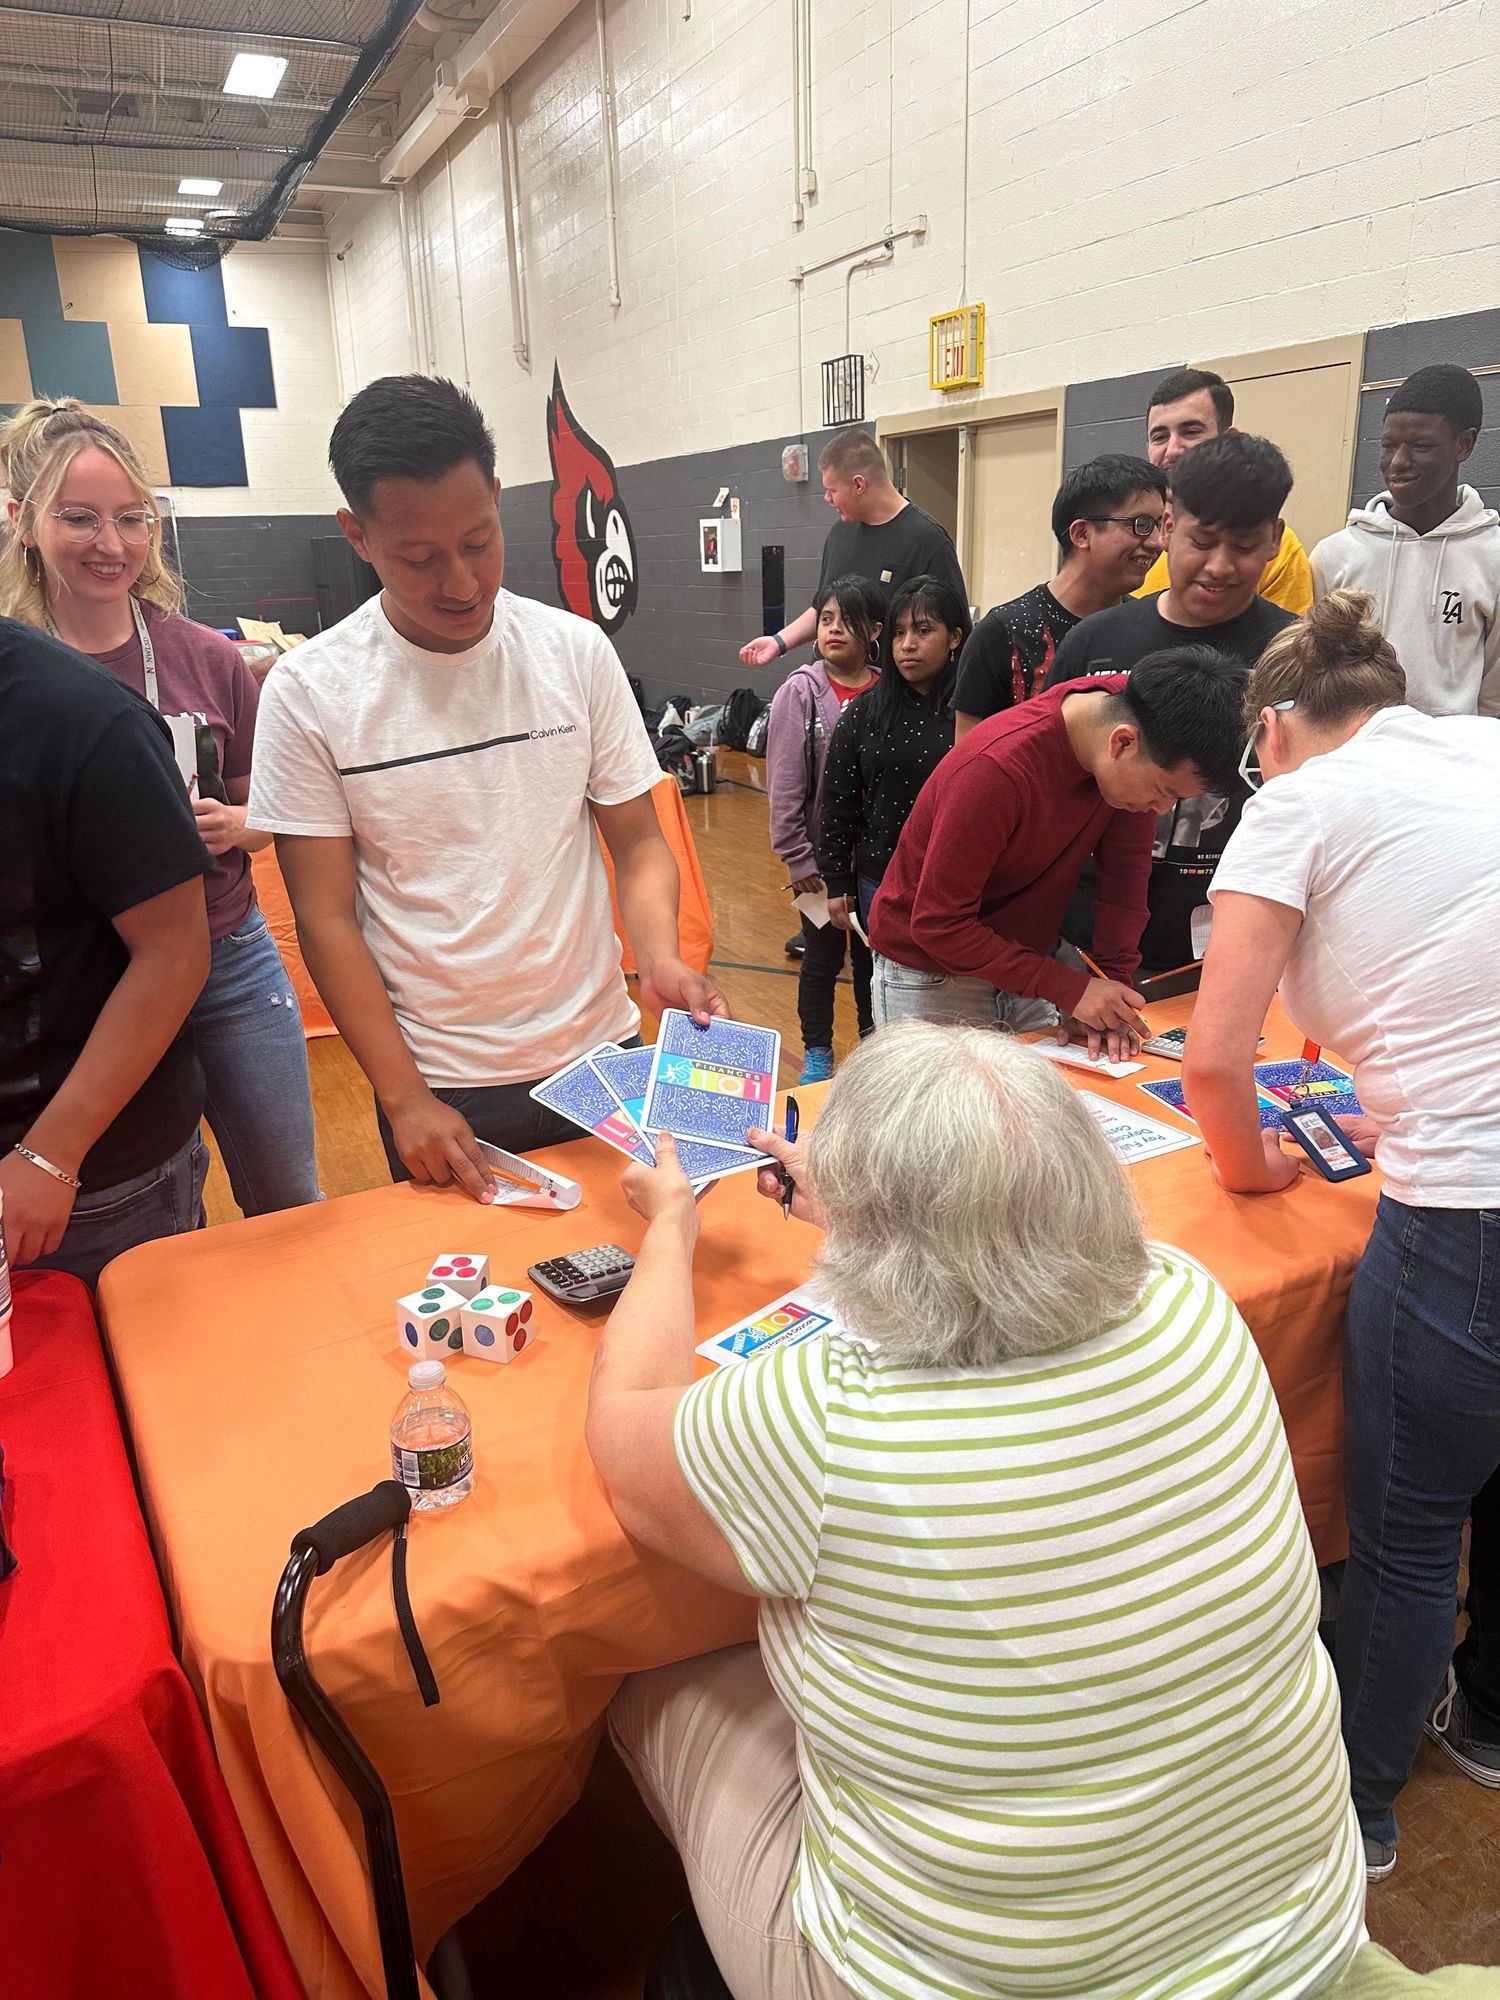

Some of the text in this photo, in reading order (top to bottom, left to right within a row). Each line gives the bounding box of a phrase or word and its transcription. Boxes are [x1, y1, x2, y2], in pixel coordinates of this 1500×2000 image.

[530, 724, 577, 740] Calvin Klein
[695, 1062, 761, 1081] FINANCES
[701, 1072, 761, 1100] 101
[1142, 1134, 1166, 1143] Pay
[756, 1305, 807, 1332] 101
